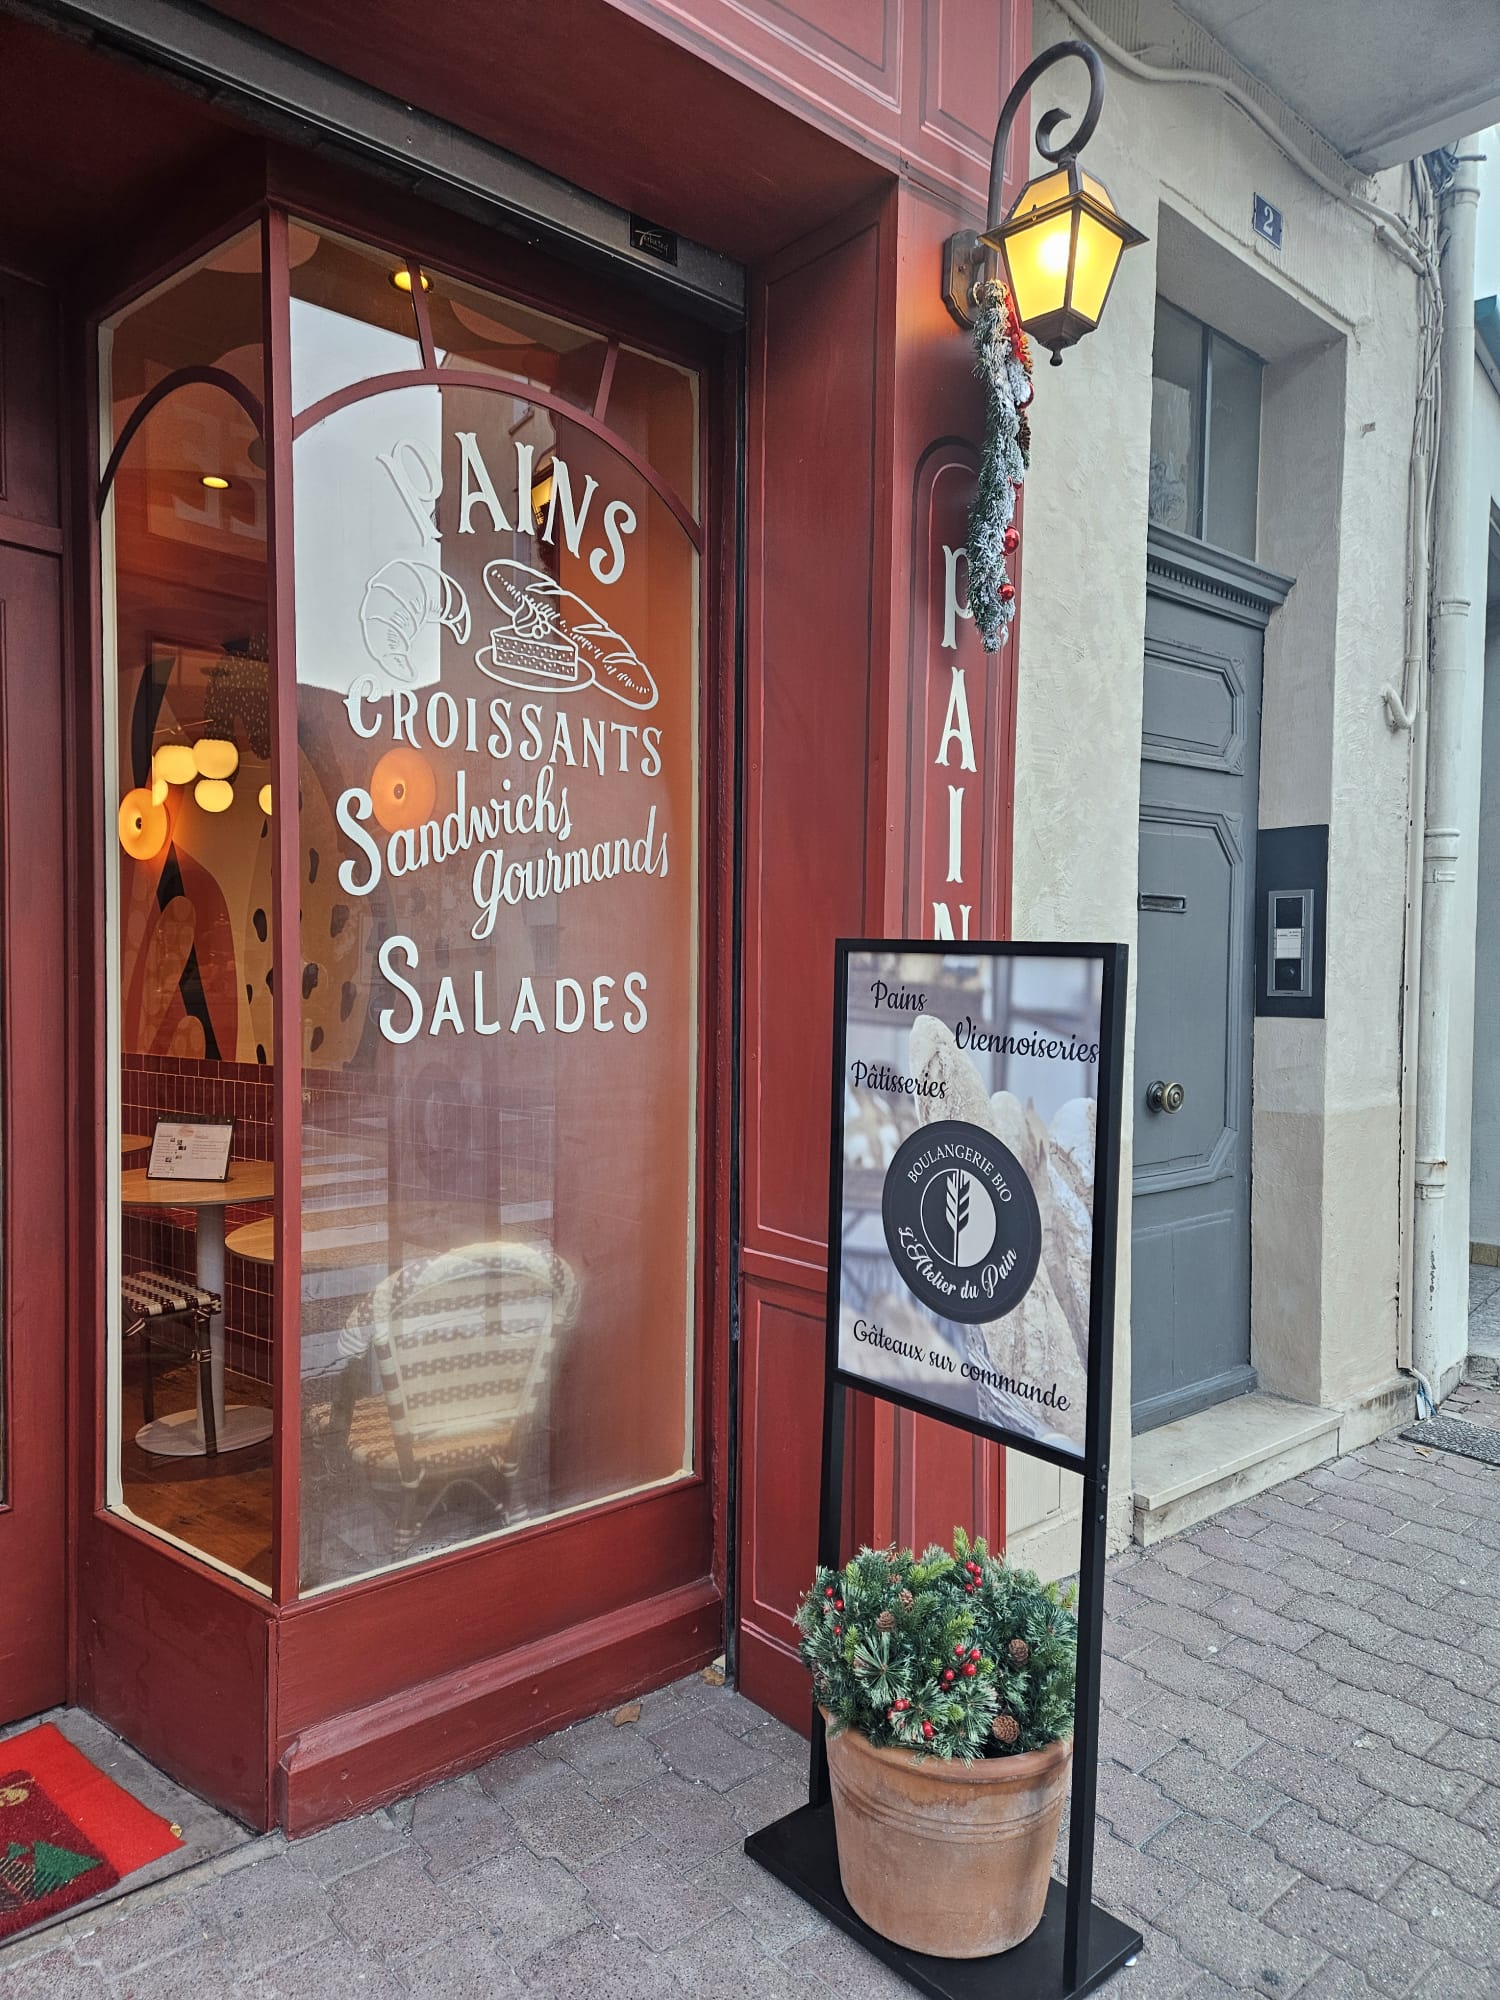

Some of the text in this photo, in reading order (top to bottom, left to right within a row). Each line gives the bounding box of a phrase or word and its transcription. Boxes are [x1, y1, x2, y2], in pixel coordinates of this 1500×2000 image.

[1263, 206, 1274, 237] 2
[376, 432, 637, 584] PAINS
[343, 674, 663, 776] CROISSANTS
[336, 765, 573, 896] Sandwichs
[471, 805, 669, 940] gourmands
[379, 935, 648, 1044] SALADES
[870, 980, 927, 1011] Pains
[851, 1060, 949, 1099] Pâtisseries
[955, 1016, 1100, 1063] Viennoiseries
[907, 1143, 1012, 1202] BOULANGERIE BIO
[898, 1226, 1017, 1299] L'Atelier du Pain
[853, 1319, 1071, 1412] Gâteaux sur commande
